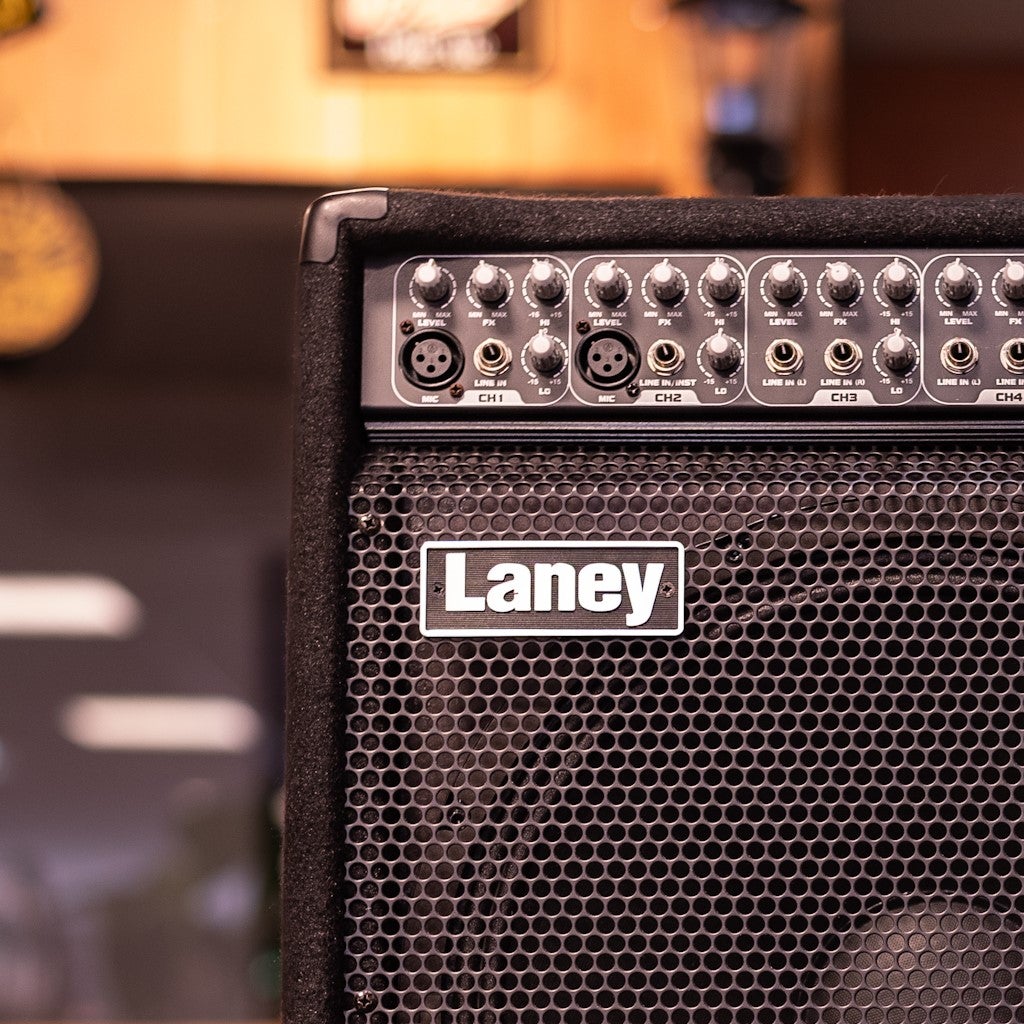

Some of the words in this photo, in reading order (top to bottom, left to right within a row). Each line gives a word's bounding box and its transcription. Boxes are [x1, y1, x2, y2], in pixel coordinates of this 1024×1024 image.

[655, 394, 682, 402] CH2
[831, 393, 857, 402] CH3
[996, 393, 1022, 401] CH4
[445, 552, 664, 627] Laney
